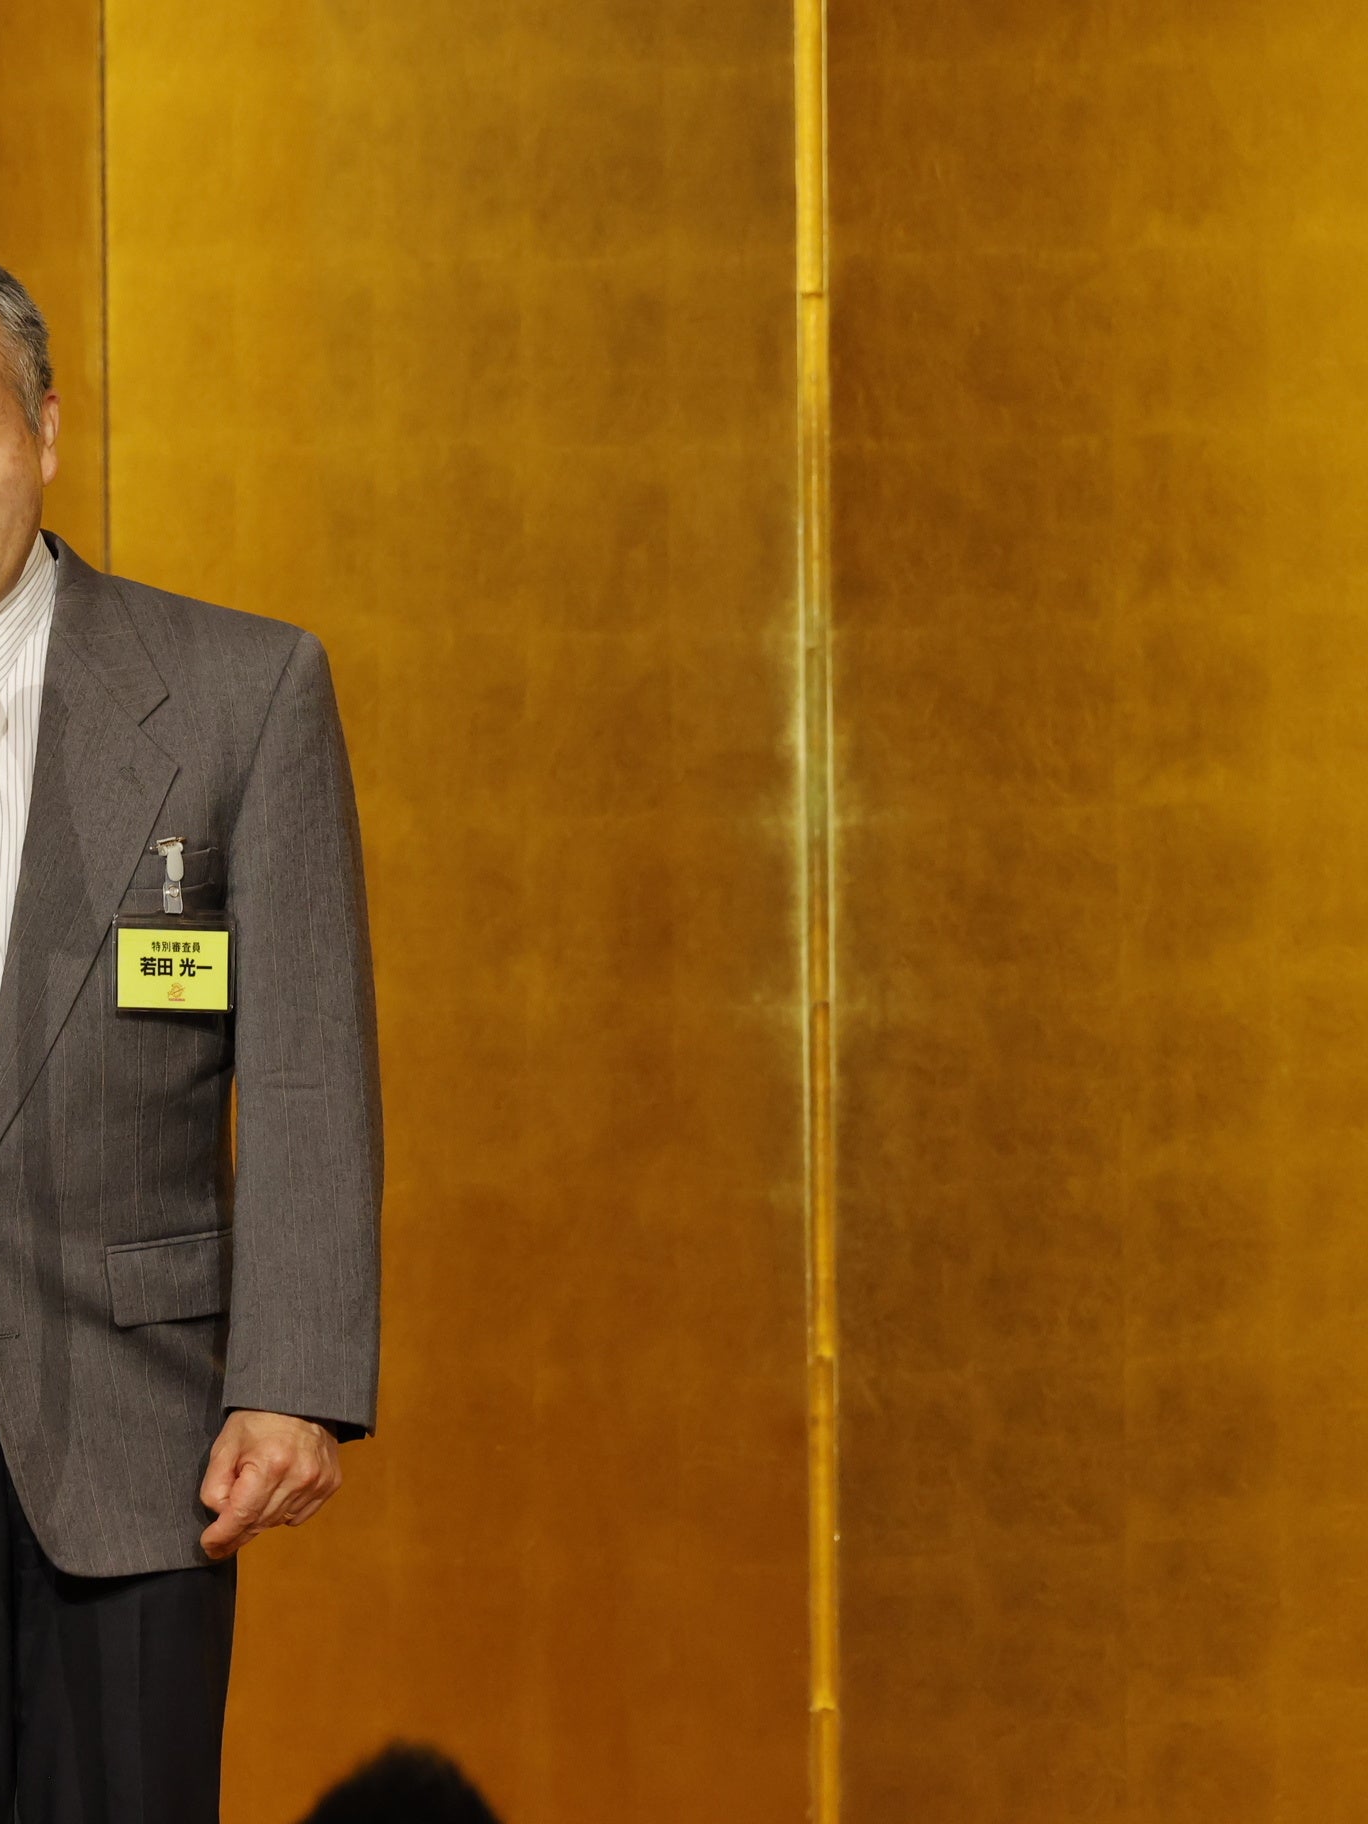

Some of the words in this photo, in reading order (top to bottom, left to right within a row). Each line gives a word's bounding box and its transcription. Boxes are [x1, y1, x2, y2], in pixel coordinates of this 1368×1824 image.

[152, 941, 201, 953] 特別審査員
[140, 957, 173, 977] 若田
[179, 957, 213, 977] 光一
